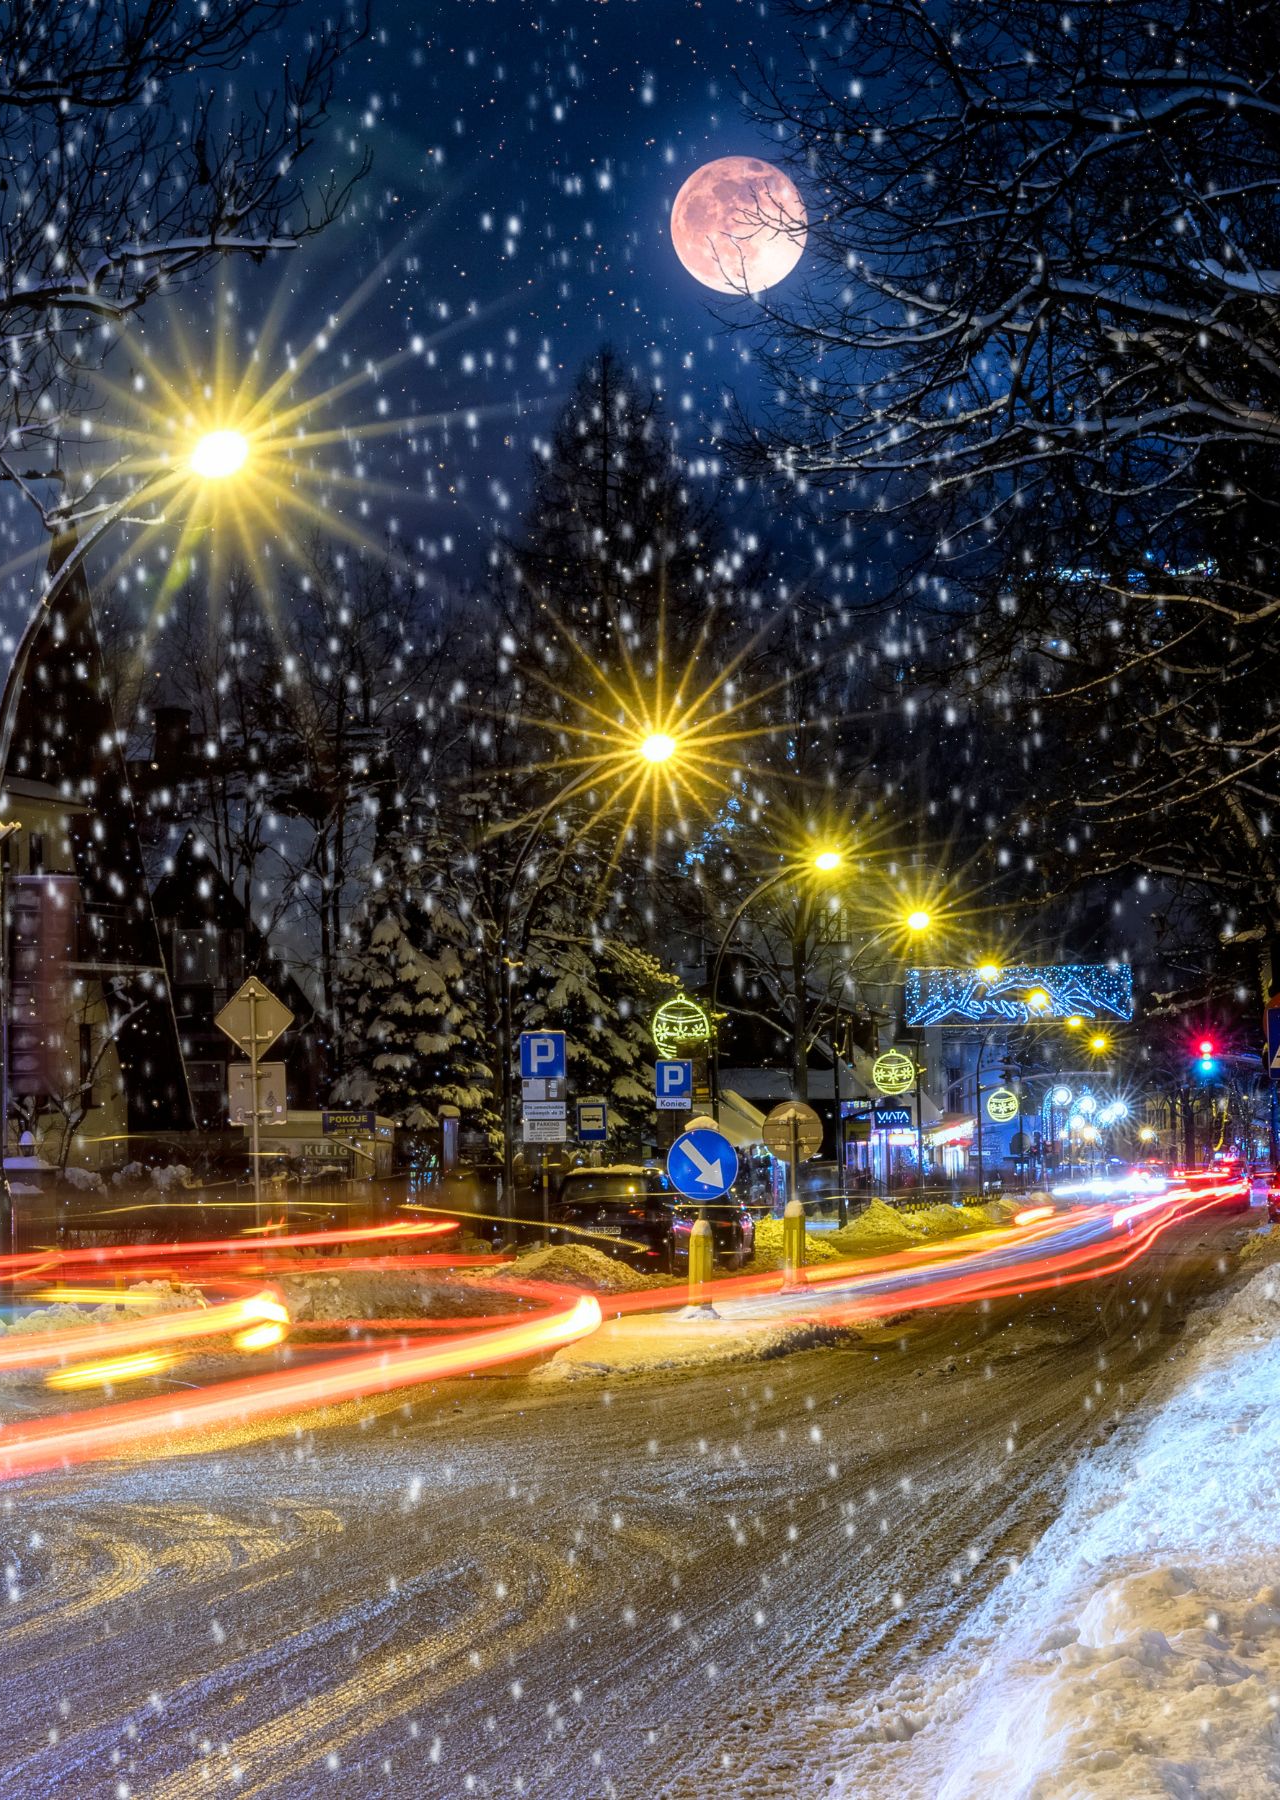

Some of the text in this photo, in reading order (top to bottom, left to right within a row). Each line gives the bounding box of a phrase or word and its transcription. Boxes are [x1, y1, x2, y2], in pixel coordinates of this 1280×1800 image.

[530, 1038, 555, 1073] P
[664, 1065, 684, 1093] P
[329, 1115, 368, 1124] POKOJE
[304, 1145, 348, 1156] KULIG
